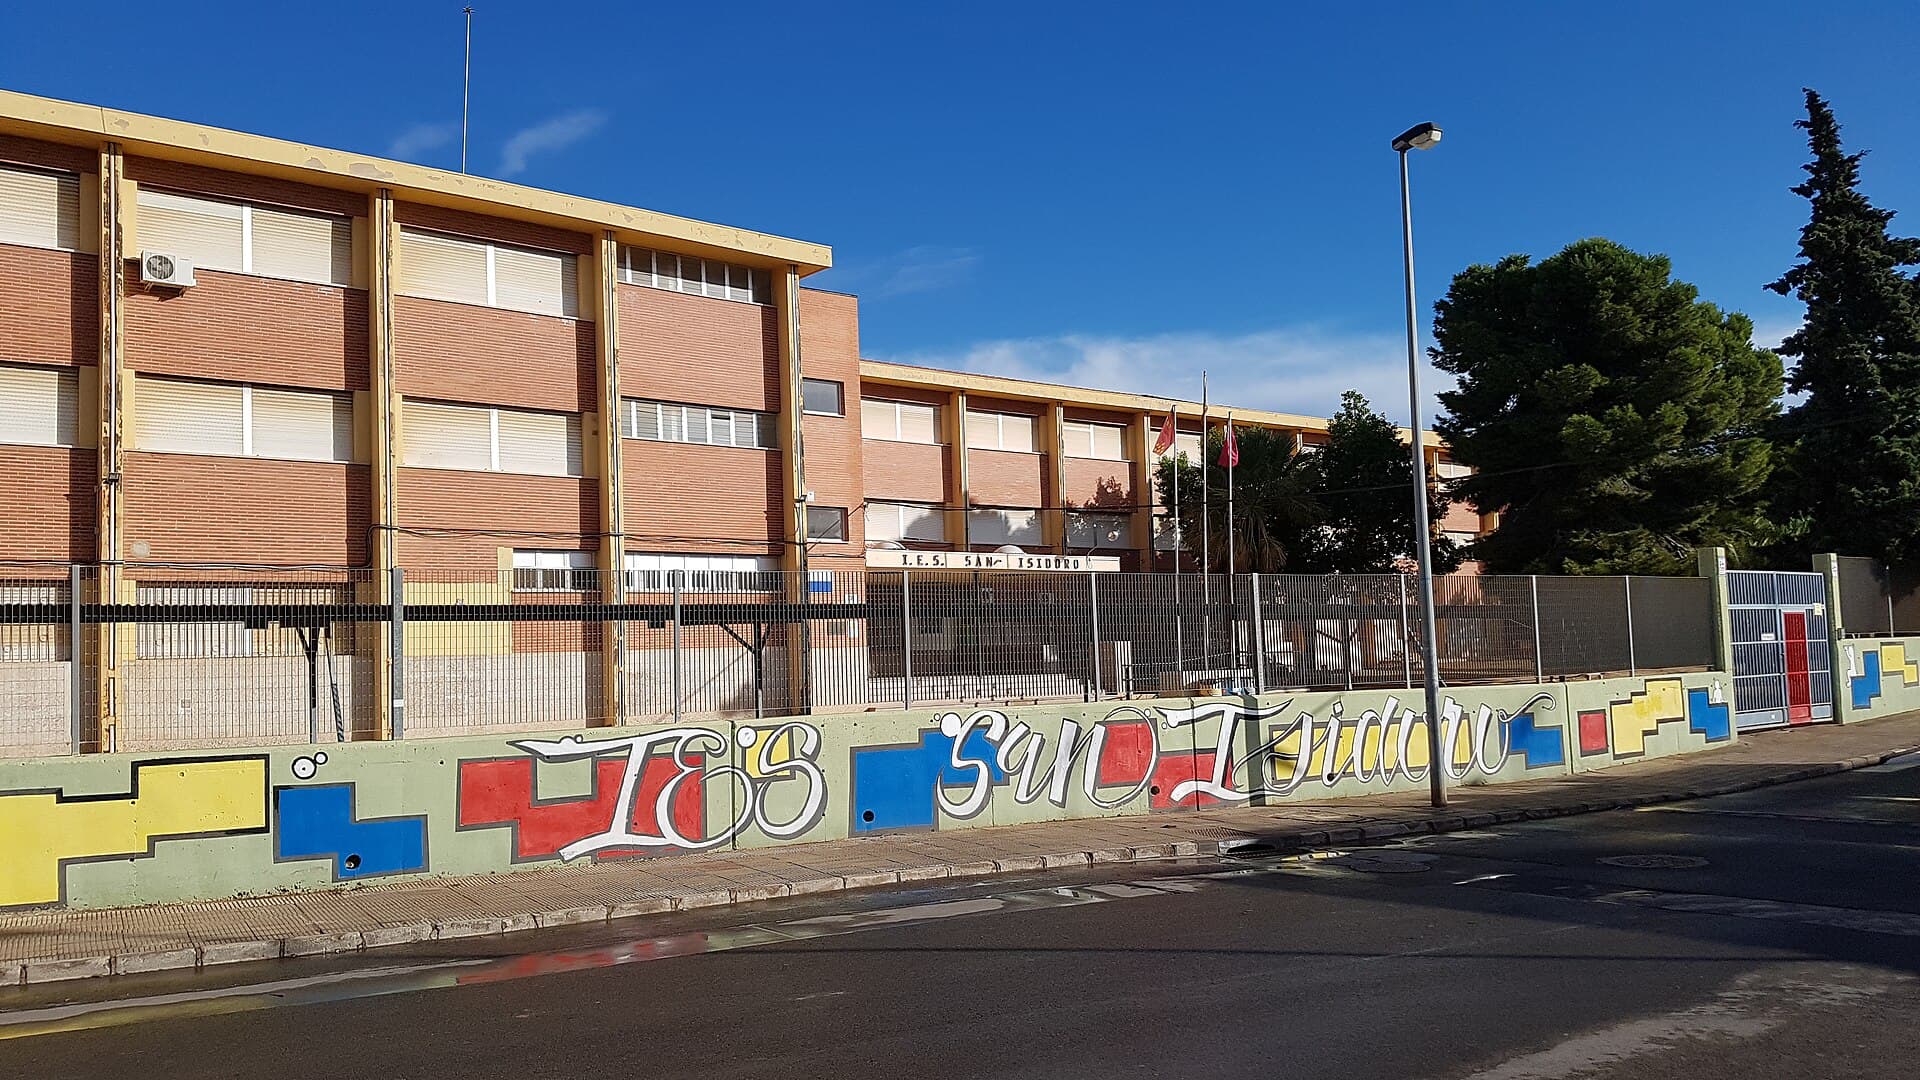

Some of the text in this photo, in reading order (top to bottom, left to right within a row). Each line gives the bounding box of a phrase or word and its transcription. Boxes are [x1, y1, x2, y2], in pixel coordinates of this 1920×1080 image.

[902, 554, 1079, 570] I.E.S. SAN ISIDORO
[506, 721, 829, 862] IES
[1152, 692, 1556, 801] Isidoro
